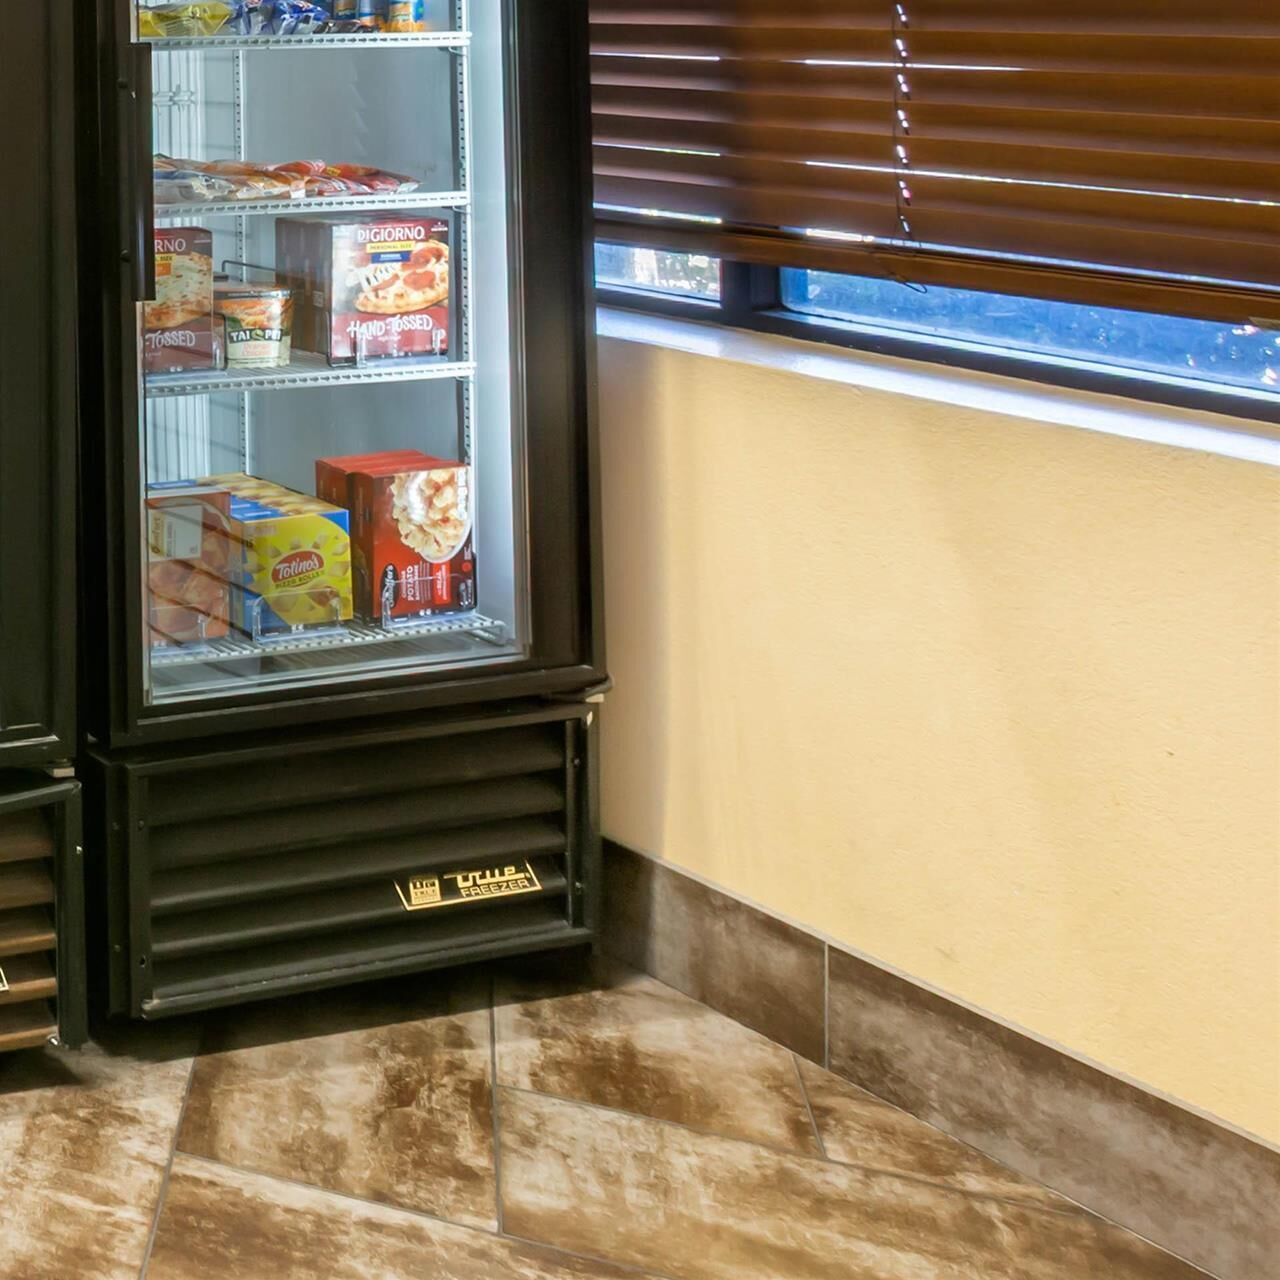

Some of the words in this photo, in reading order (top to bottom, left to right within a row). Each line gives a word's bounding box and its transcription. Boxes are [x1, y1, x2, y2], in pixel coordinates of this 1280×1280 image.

[145, 330, 196, 348] -TOSSED
[229, 329, 251, 342] TAI
[275, 552, 320, 581] Totino's
[443, 866, 526, 889] true
[460, 878, 530, 898] FREEZER
